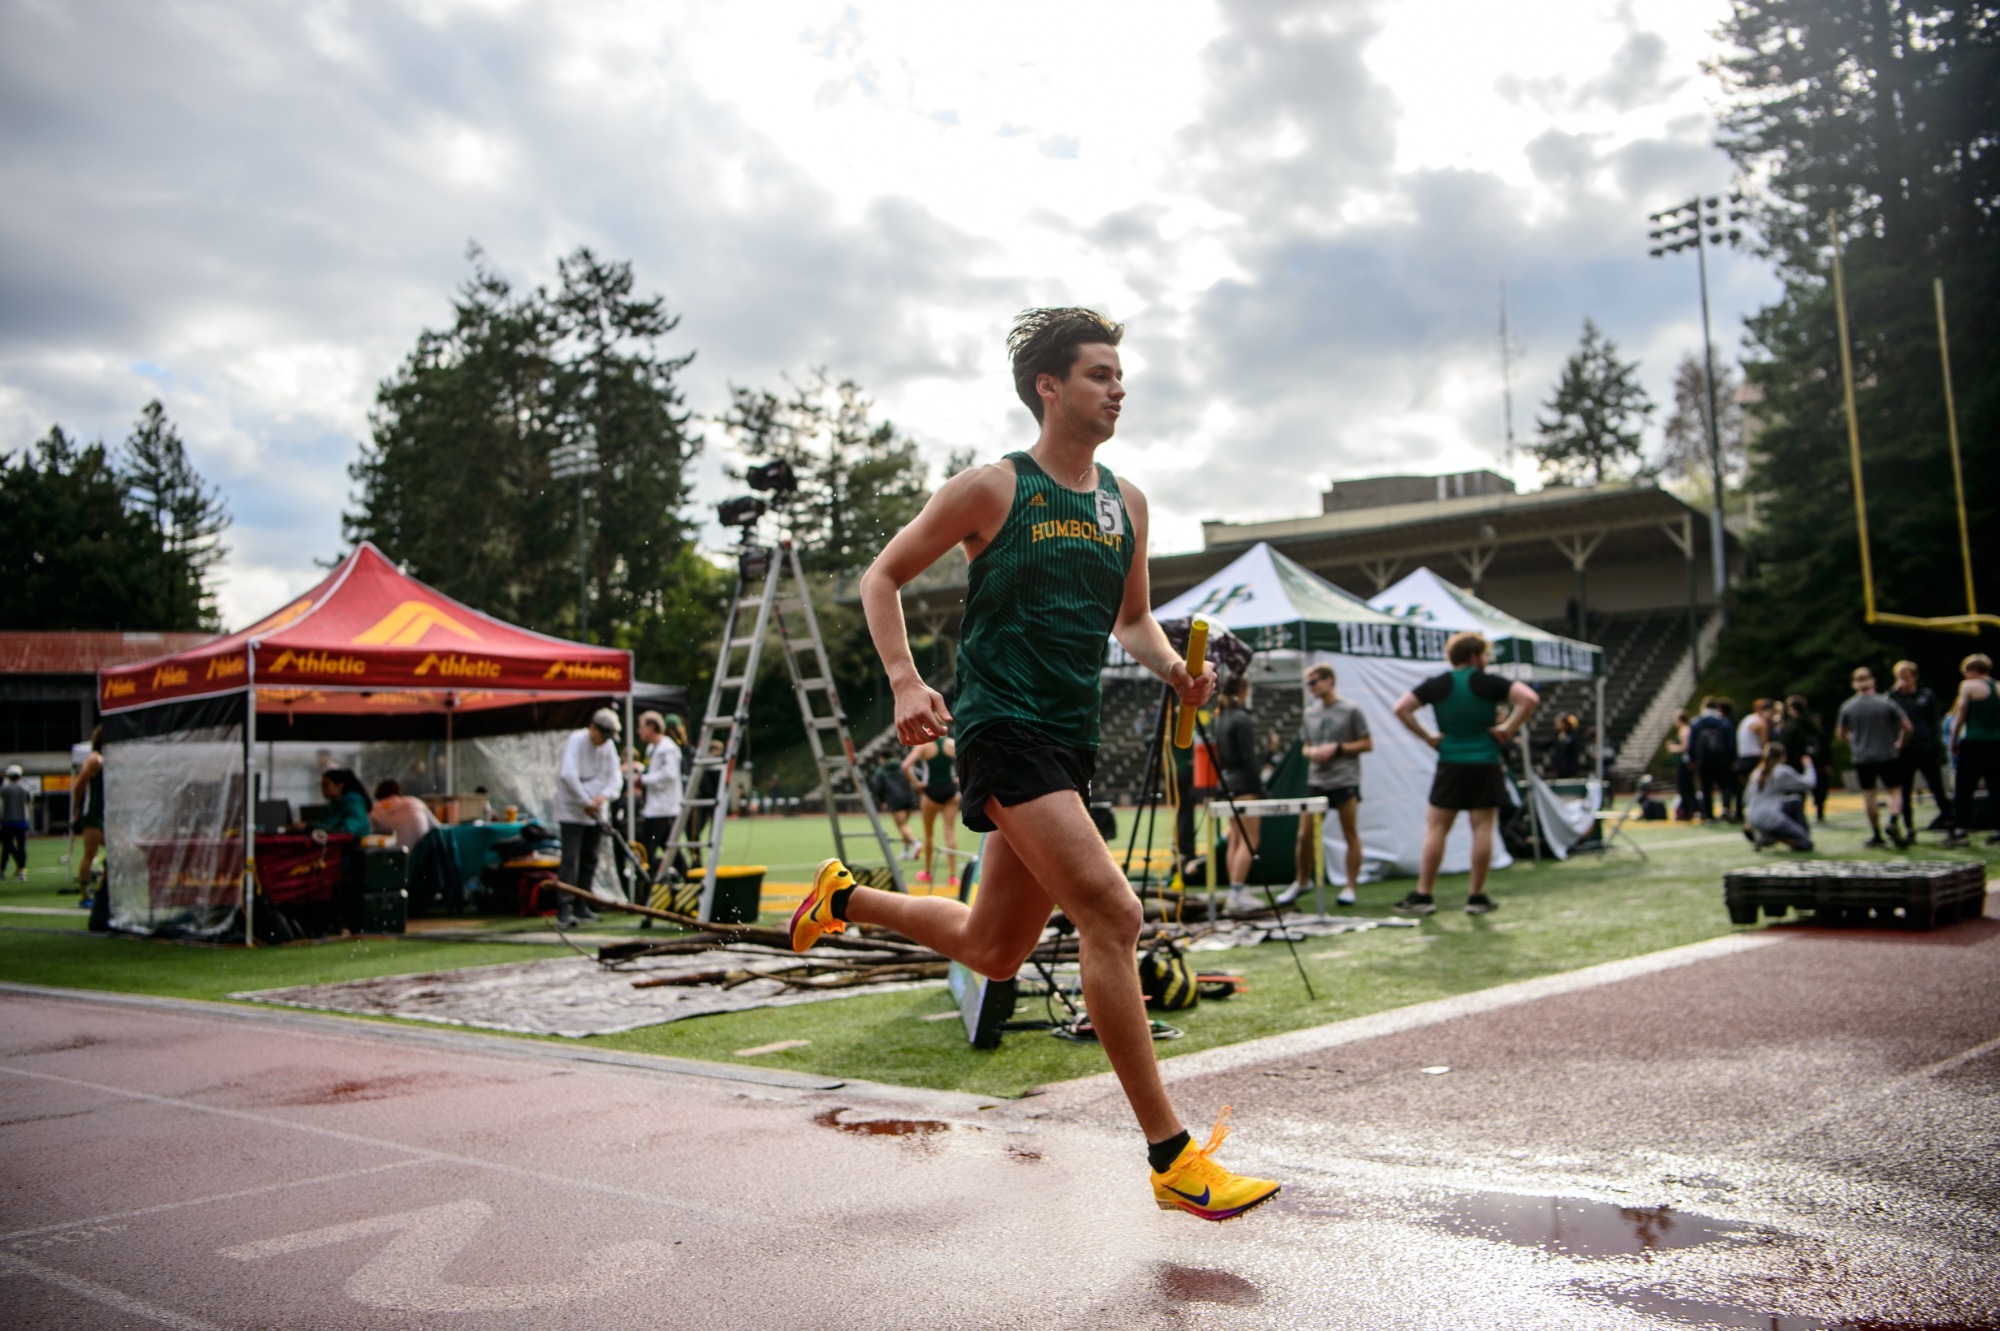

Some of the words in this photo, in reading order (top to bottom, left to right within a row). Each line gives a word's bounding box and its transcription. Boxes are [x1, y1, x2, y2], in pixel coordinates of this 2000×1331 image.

[1100, 500, 1115, 531] 5
[269, 649, 365, 675] Athletic
[414, 653, 501, 678] Athletic
[543, 660, 623, 681] Athletic
